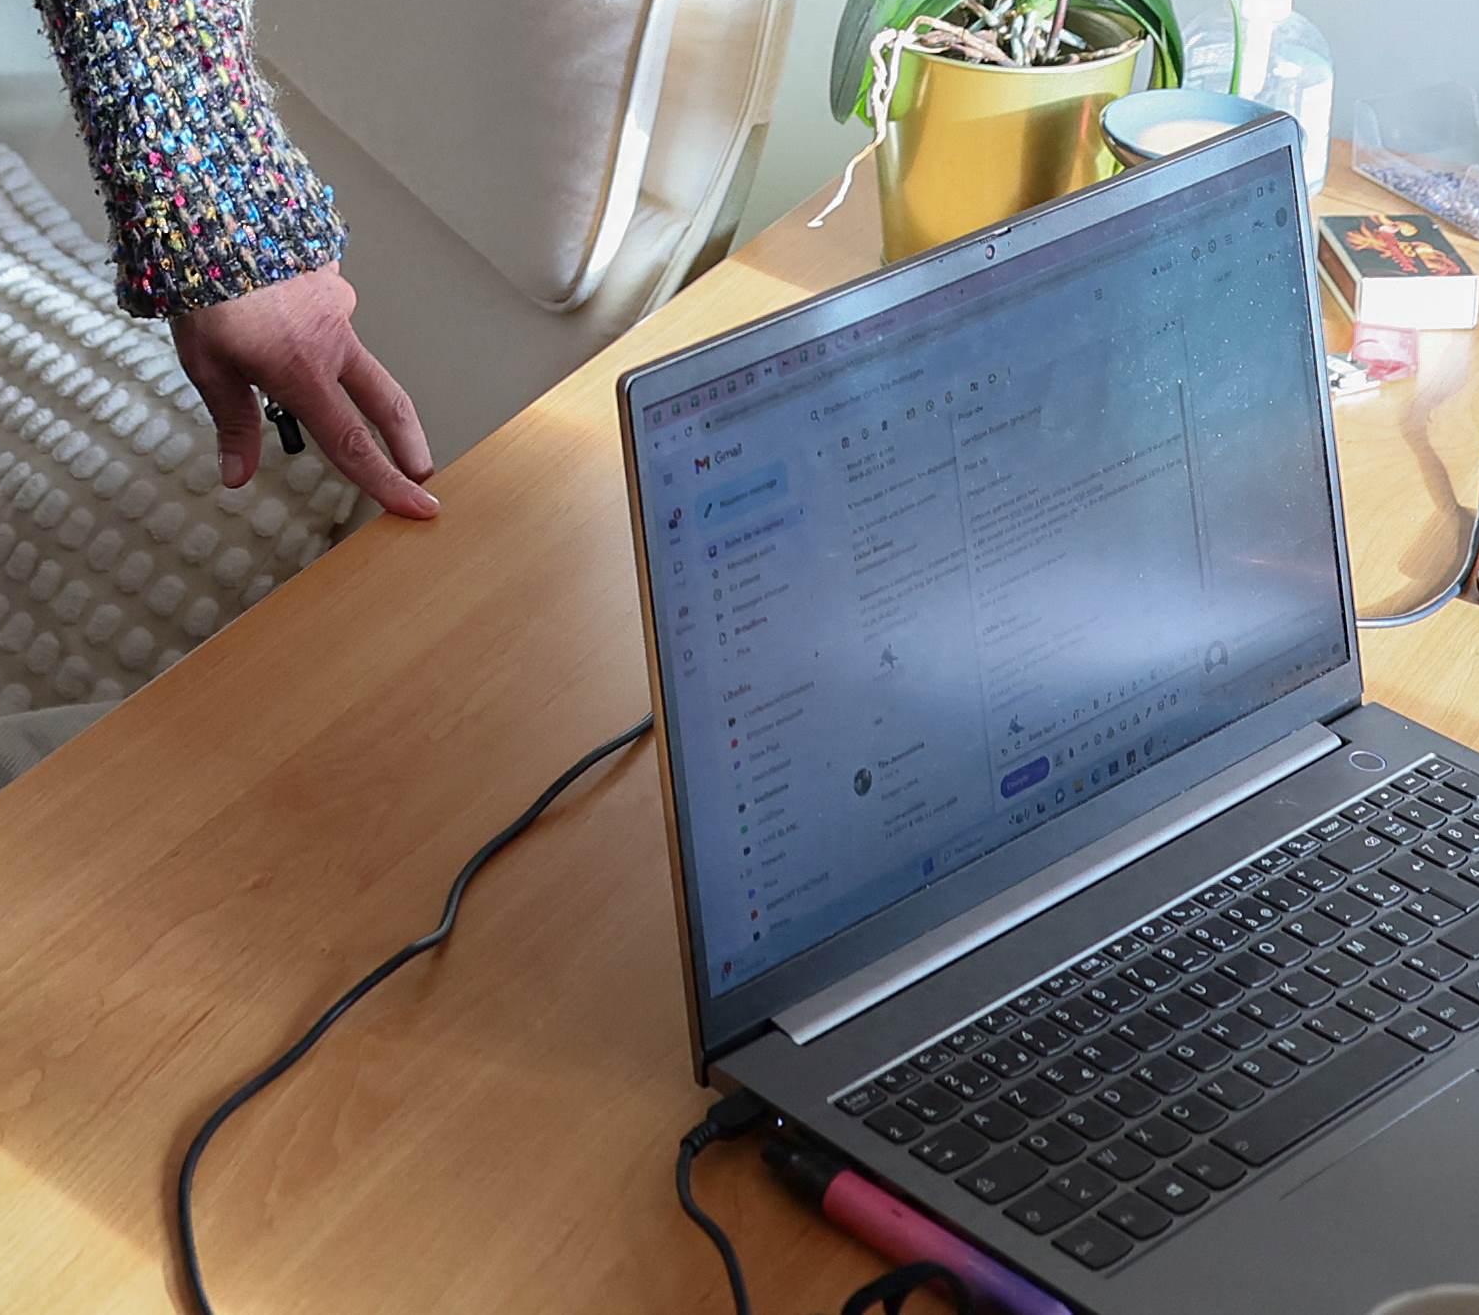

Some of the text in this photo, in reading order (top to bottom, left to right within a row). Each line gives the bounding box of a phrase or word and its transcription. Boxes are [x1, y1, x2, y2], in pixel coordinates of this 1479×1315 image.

[714, 443, 743, 465] Gmail
[1448, 828, 1462, 839] 8
[1422, 844, 1435, 854] 7
[1229, 909, 1242, 920] 0
[1195, 928, 1210, 939] 9
[1291, 922, 1304, 935] P
[1258, 943, 1275, 955] O
[1346, 940, 1366, 954] M
[1160, 948, 1176, 959] 8
[1313, 964, 1330, 976] L
[1092, 989, 1106, 1000] 6
[1190, 983, 1206, 995] U
[1280, 983, 1298, 995] K
[1055, 1009, 1070, 1020] 5
[1157, 1003, 1171, 1015] Y
[1248, 1003, 1262, 1016] J
[1020, 1030, 1034, 1042] 4
[1120, 1024, 1135, 1036] T
[1211, 1023, 1229, 1037] H
[1277, 1038, 1296, 1051] N
[1083, 1047, 1101, 1060] R
[1177, 1045, 1194, 1059] G
[1243, 1061, 1260, 1075] B
[1140, 1068, 1154, 1081] F
[944, 1075, 961, 1087] 2
[1207, 1081, 1224, 1096] V
[1009, 1089, 1027, 1105] Z
[1104, 1090, 1120, 1103] D
[1172, 1105, 1189, 1119] C
[974, 1113, 990, 1126] A
